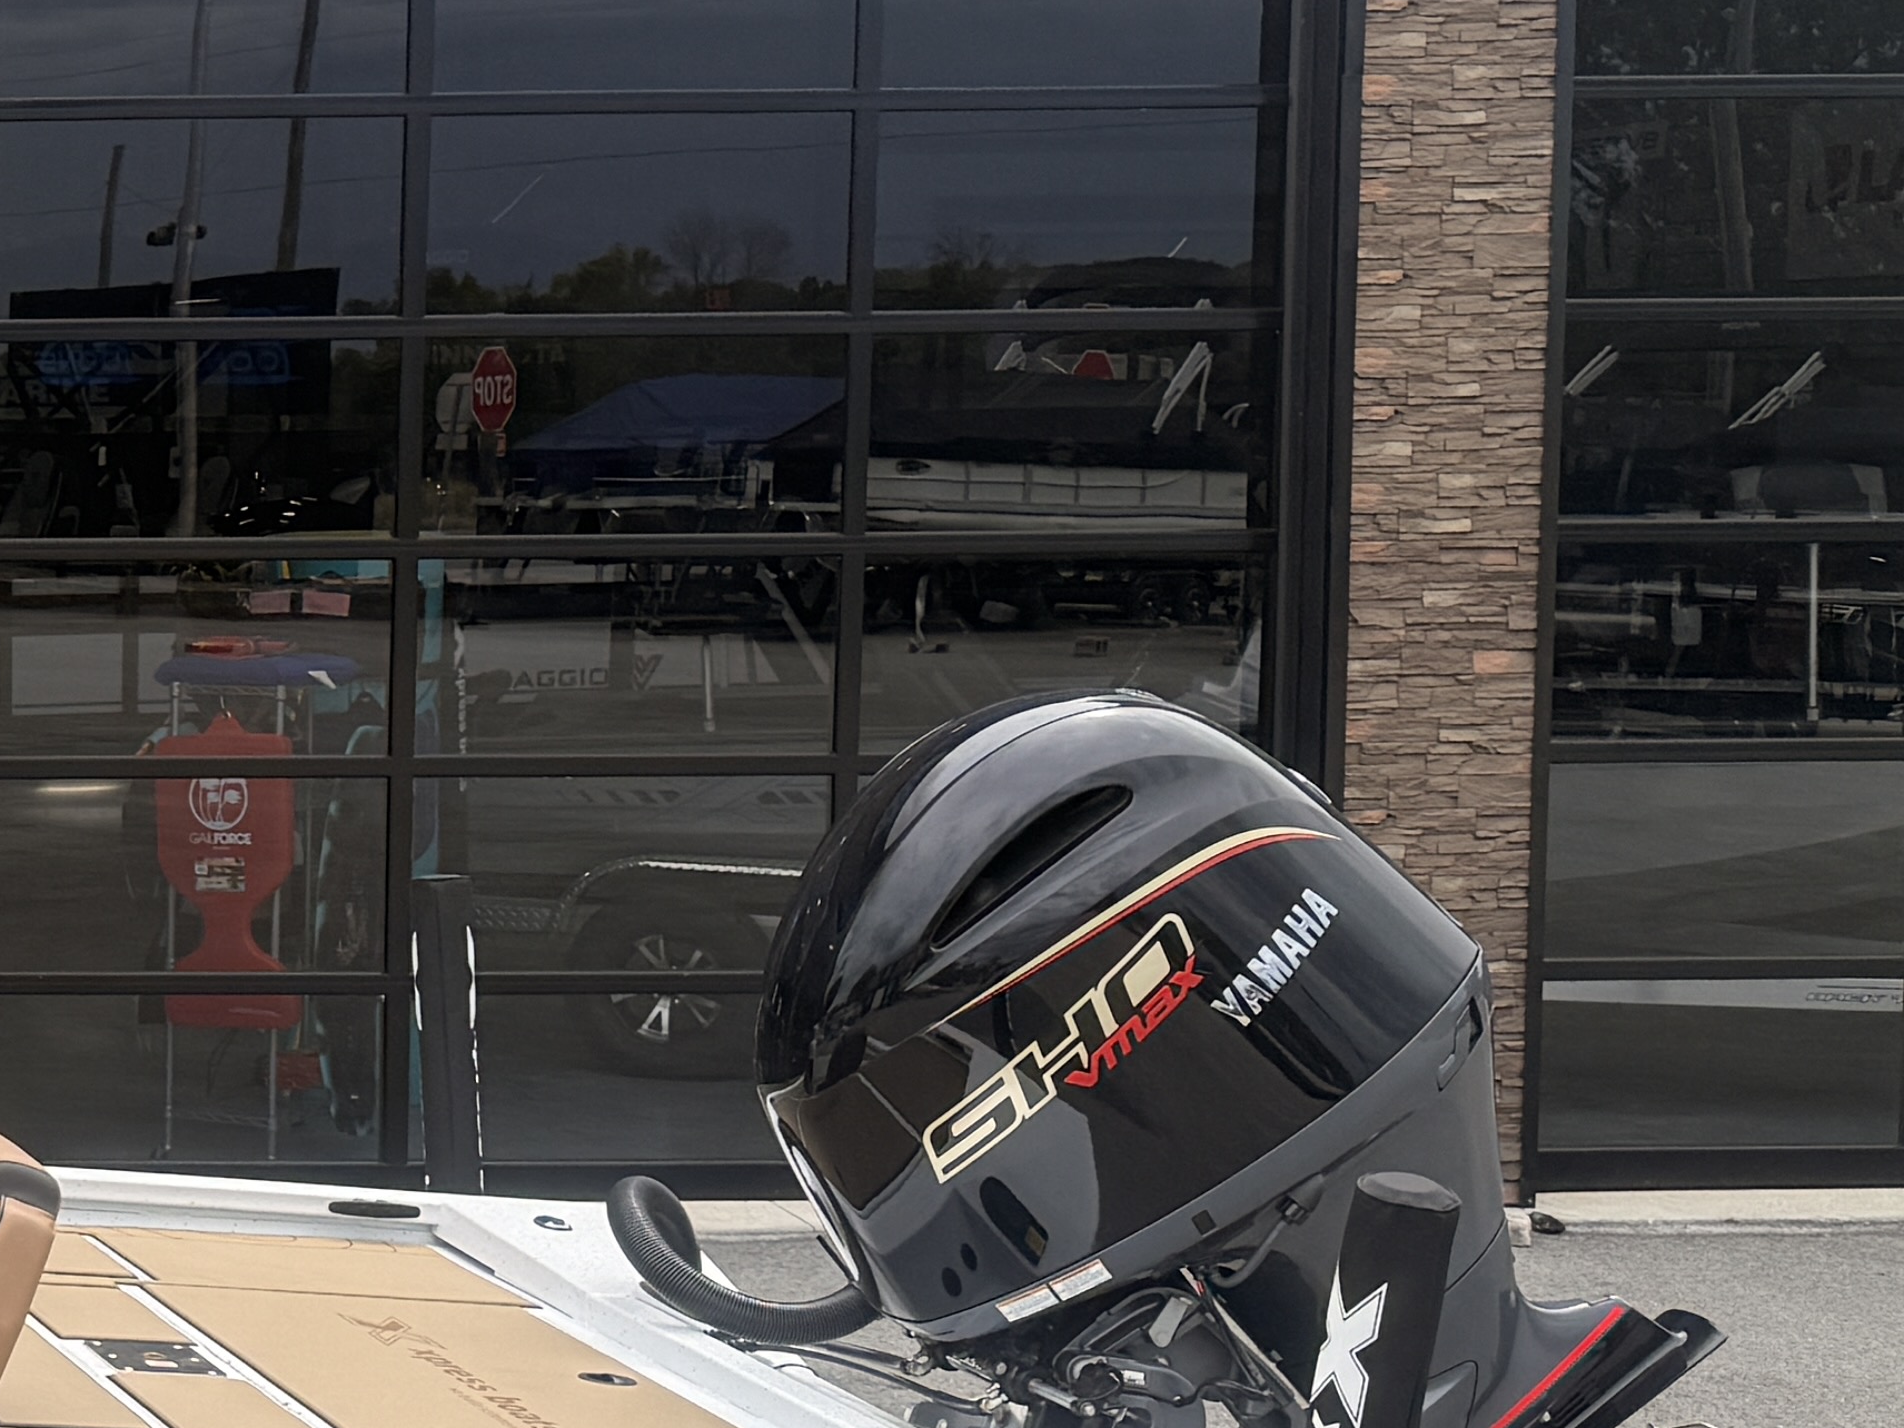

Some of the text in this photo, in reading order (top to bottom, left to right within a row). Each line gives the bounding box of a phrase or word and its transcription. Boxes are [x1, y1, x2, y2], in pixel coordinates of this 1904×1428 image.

[1211, 887, 1340, 1028] YAMAHA
[921, 912, 1197, 1184] SHO
[407, 1346, 498, 1393] xpress
